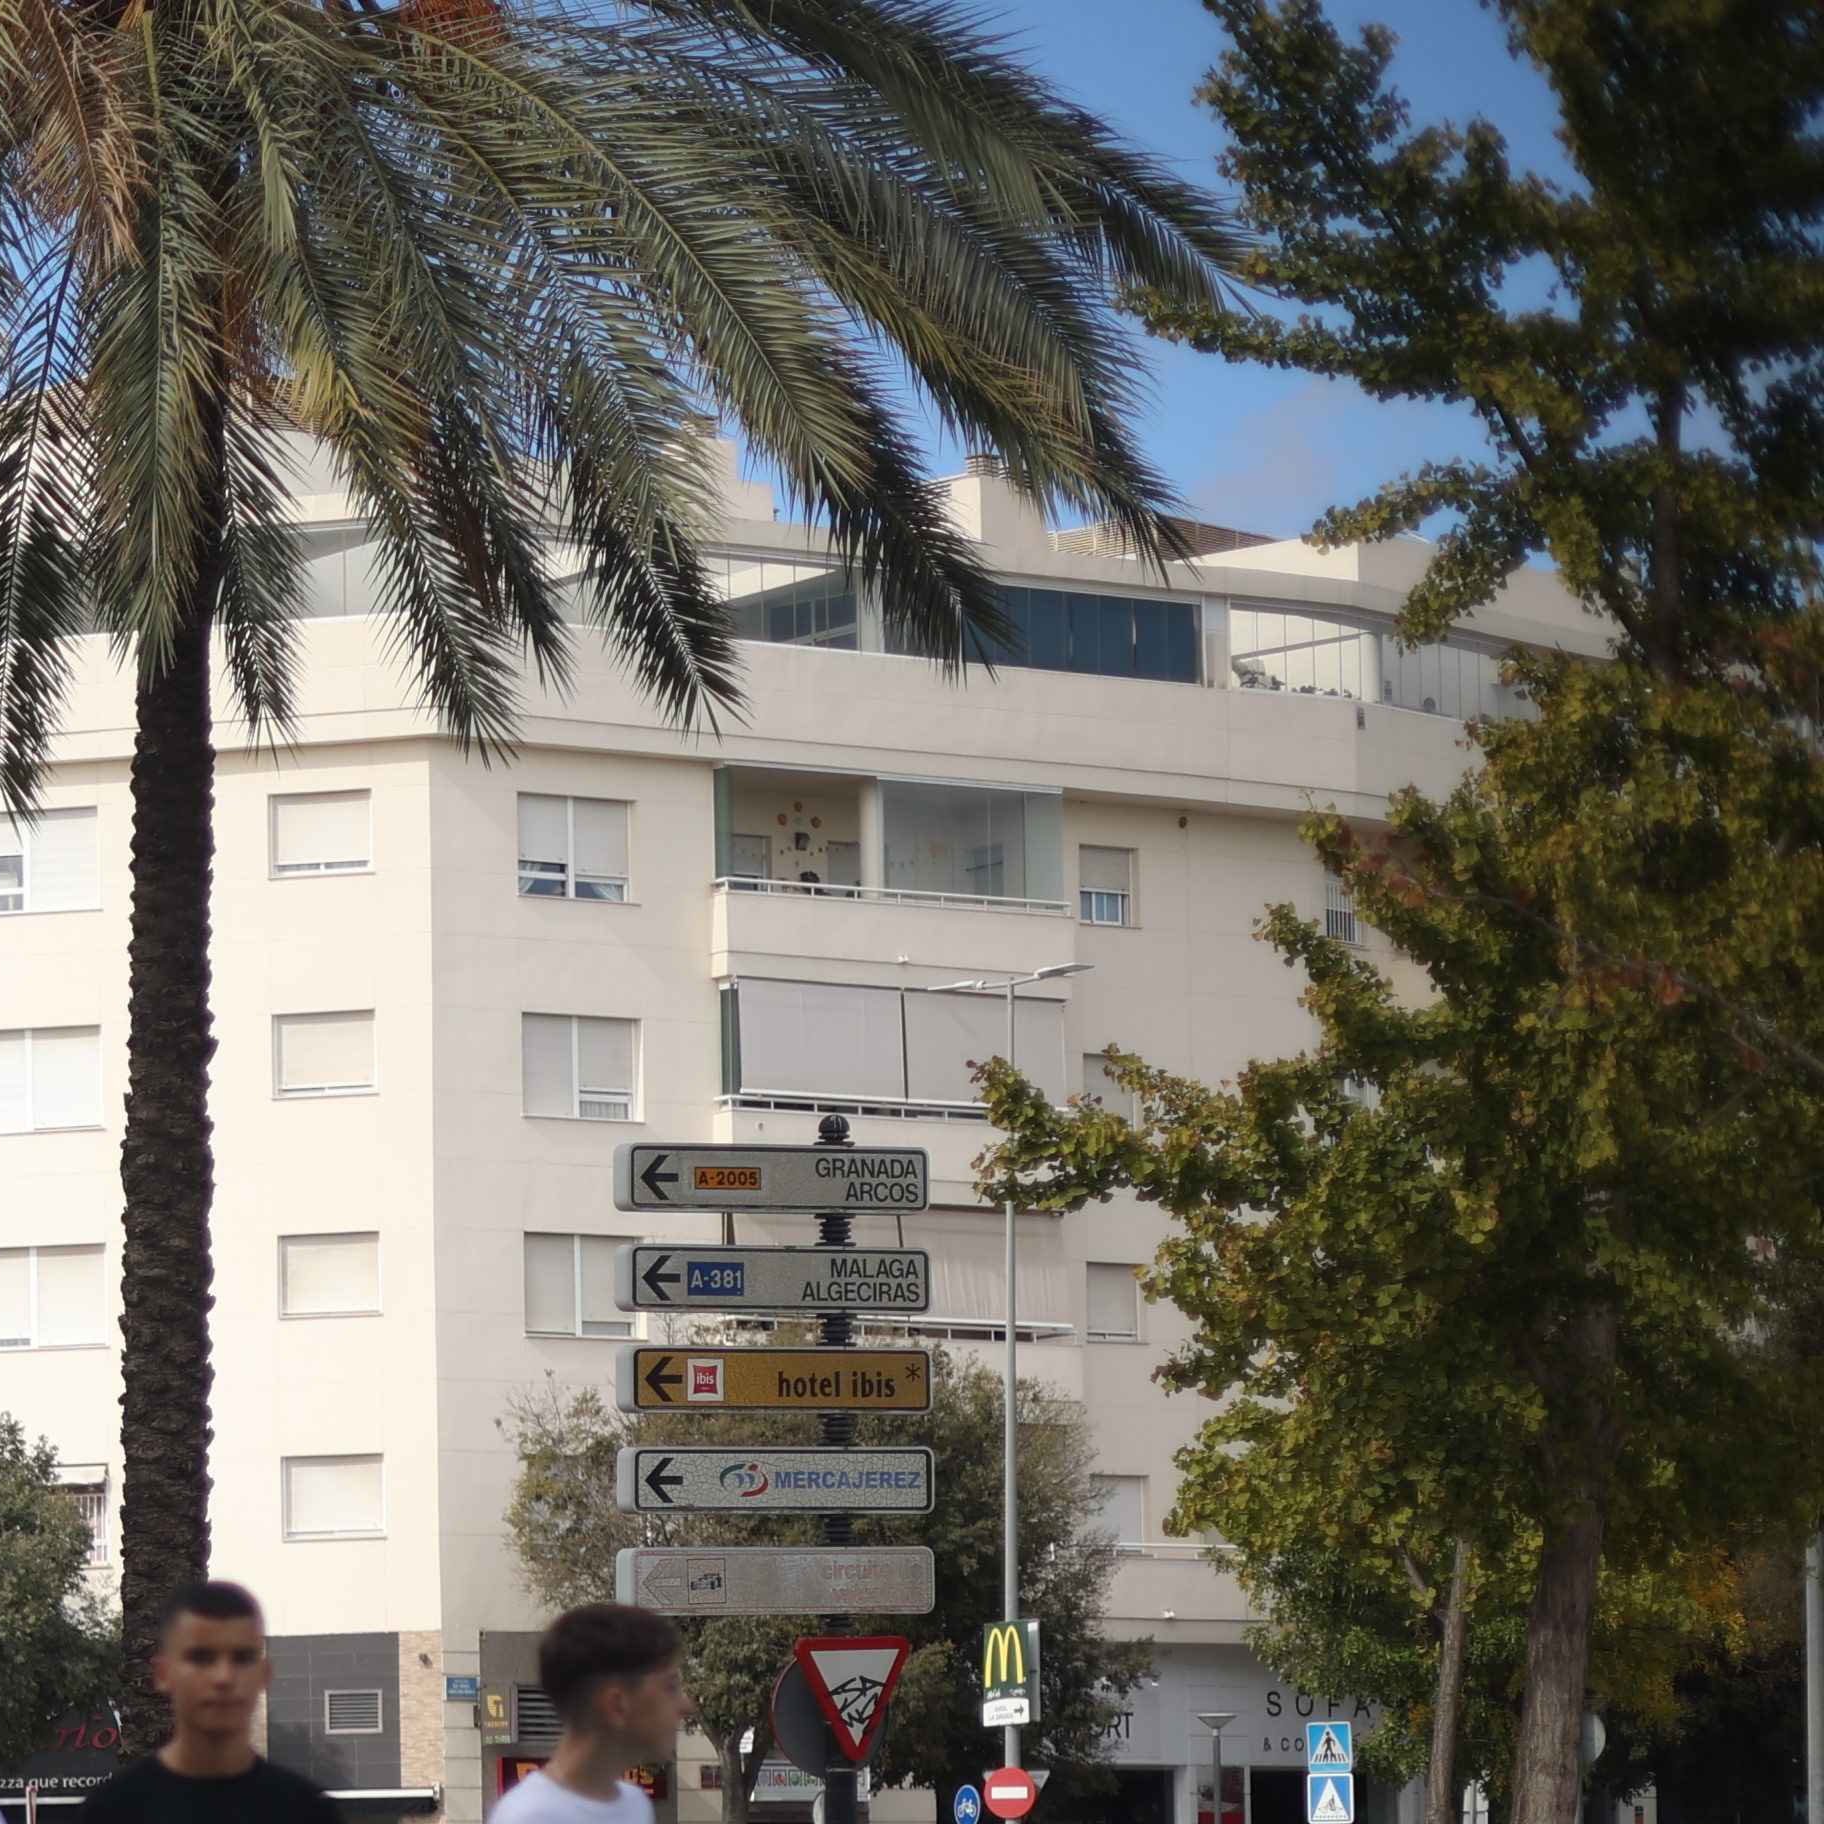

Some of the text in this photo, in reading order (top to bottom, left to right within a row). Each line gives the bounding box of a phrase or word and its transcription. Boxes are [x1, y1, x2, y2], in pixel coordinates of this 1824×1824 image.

[697, 1170, 759, 1187] A-2005
[814, 1157, 919, 1180] GRANADA
[845, 1182, 920, 1203] ARCOS
[690, 1268, 743, 1290] A-381
[830, 1257, 920, 1280] MALAGA
[802, 1281, 921, 1304] ALGECIRAS
[696, 1371, 715, 1385] ibis
[777, 1370, 897, 1399] hotel ibis
[774, 1471, 922, 1490] MERCAJEREZ
